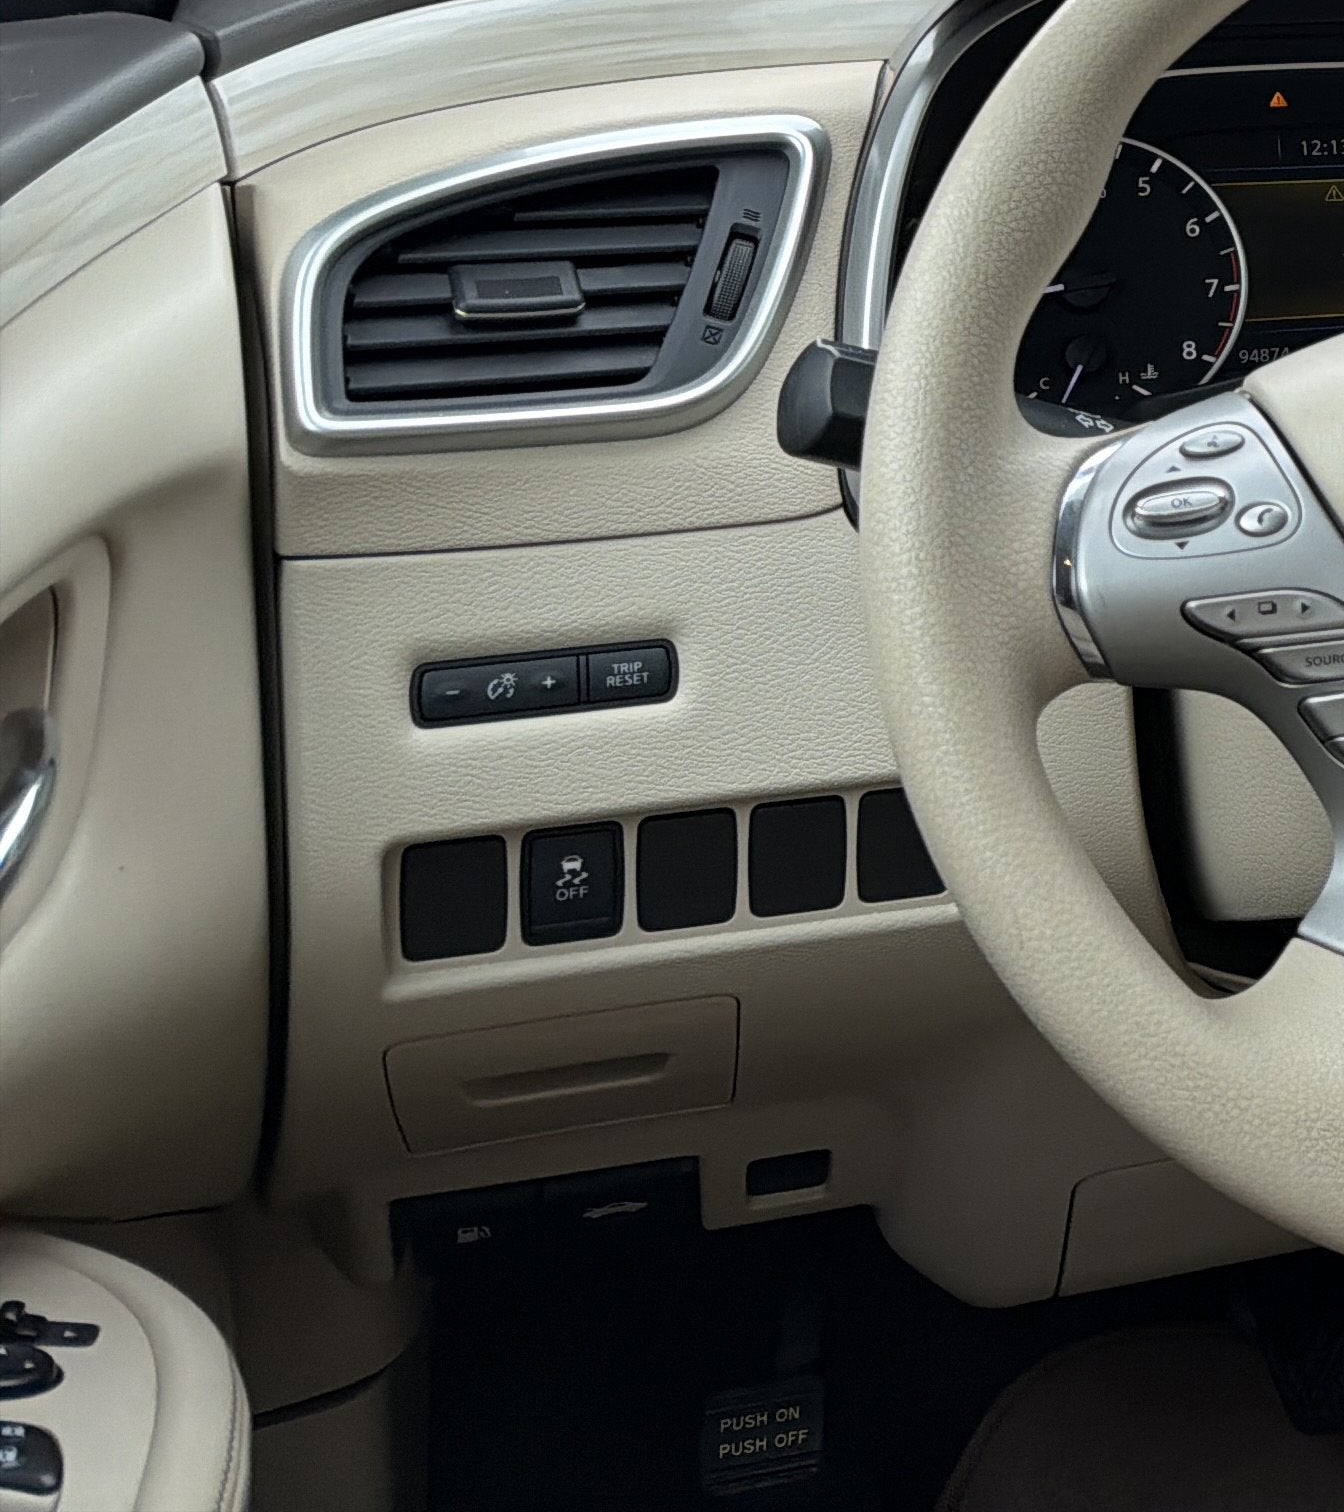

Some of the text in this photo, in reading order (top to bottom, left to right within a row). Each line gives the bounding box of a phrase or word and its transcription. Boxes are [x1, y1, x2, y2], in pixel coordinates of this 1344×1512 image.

[1137, 177, 1151, 196] 5
[1185, 218, 1200, 237] 6
[1205, 279, 1219, 298] 7
[1182, 341, 1197, 360] 8
[1039, 377, 1050, 390] C
[1119, 372, 1129, 384] H
[1171, 497, 1192, 508] OK
[612, 661, 642, 675] TRIP
[606, 671, 649, 688] RESET
[556, 886, 589, 901] OFF
[720, 1406, 800, 1432] PUSH ON
[719, 1429, 809, 1459] PUSH OFF
